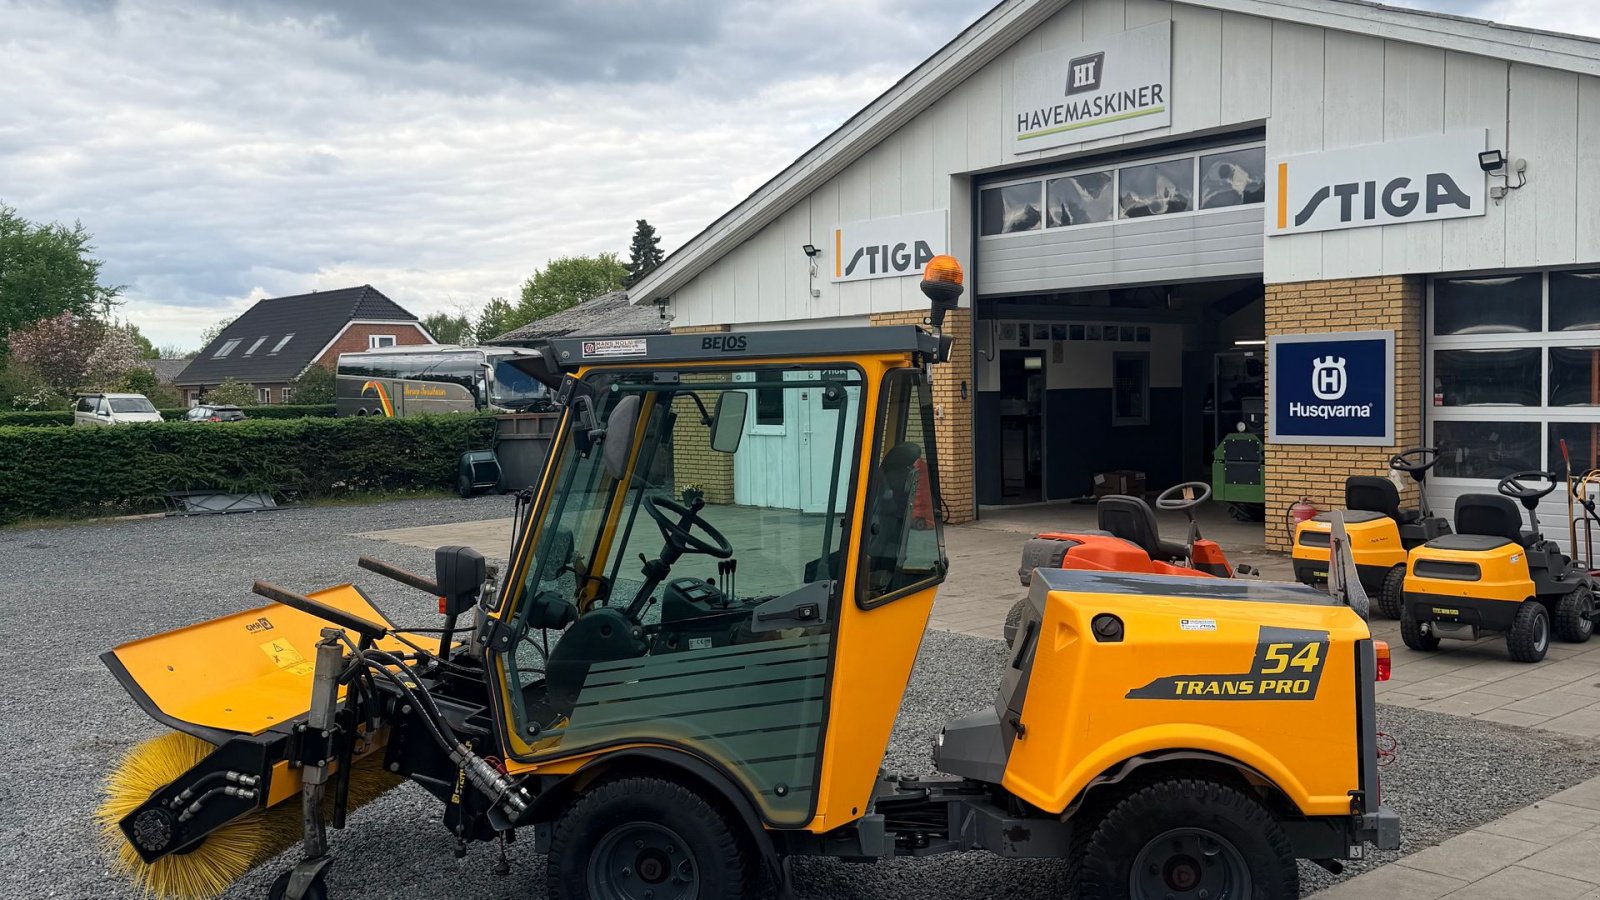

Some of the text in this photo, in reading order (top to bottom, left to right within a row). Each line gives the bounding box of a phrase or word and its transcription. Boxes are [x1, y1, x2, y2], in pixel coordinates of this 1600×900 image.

[1074, 62, 1095, 87] HI
[1017, 83, 1163, 132] HAVEMASKINER
[1295, 172, 1471, 227] STIGA
[845, 240, 935, 276] STIGA
[701, 336, 747, 352] BELOS
[1289, 401, 1370, 419] Husqvarna
[1261, 642, 1320, 674] 54
[1174, 679, 1310, 695] TRANS PRO
